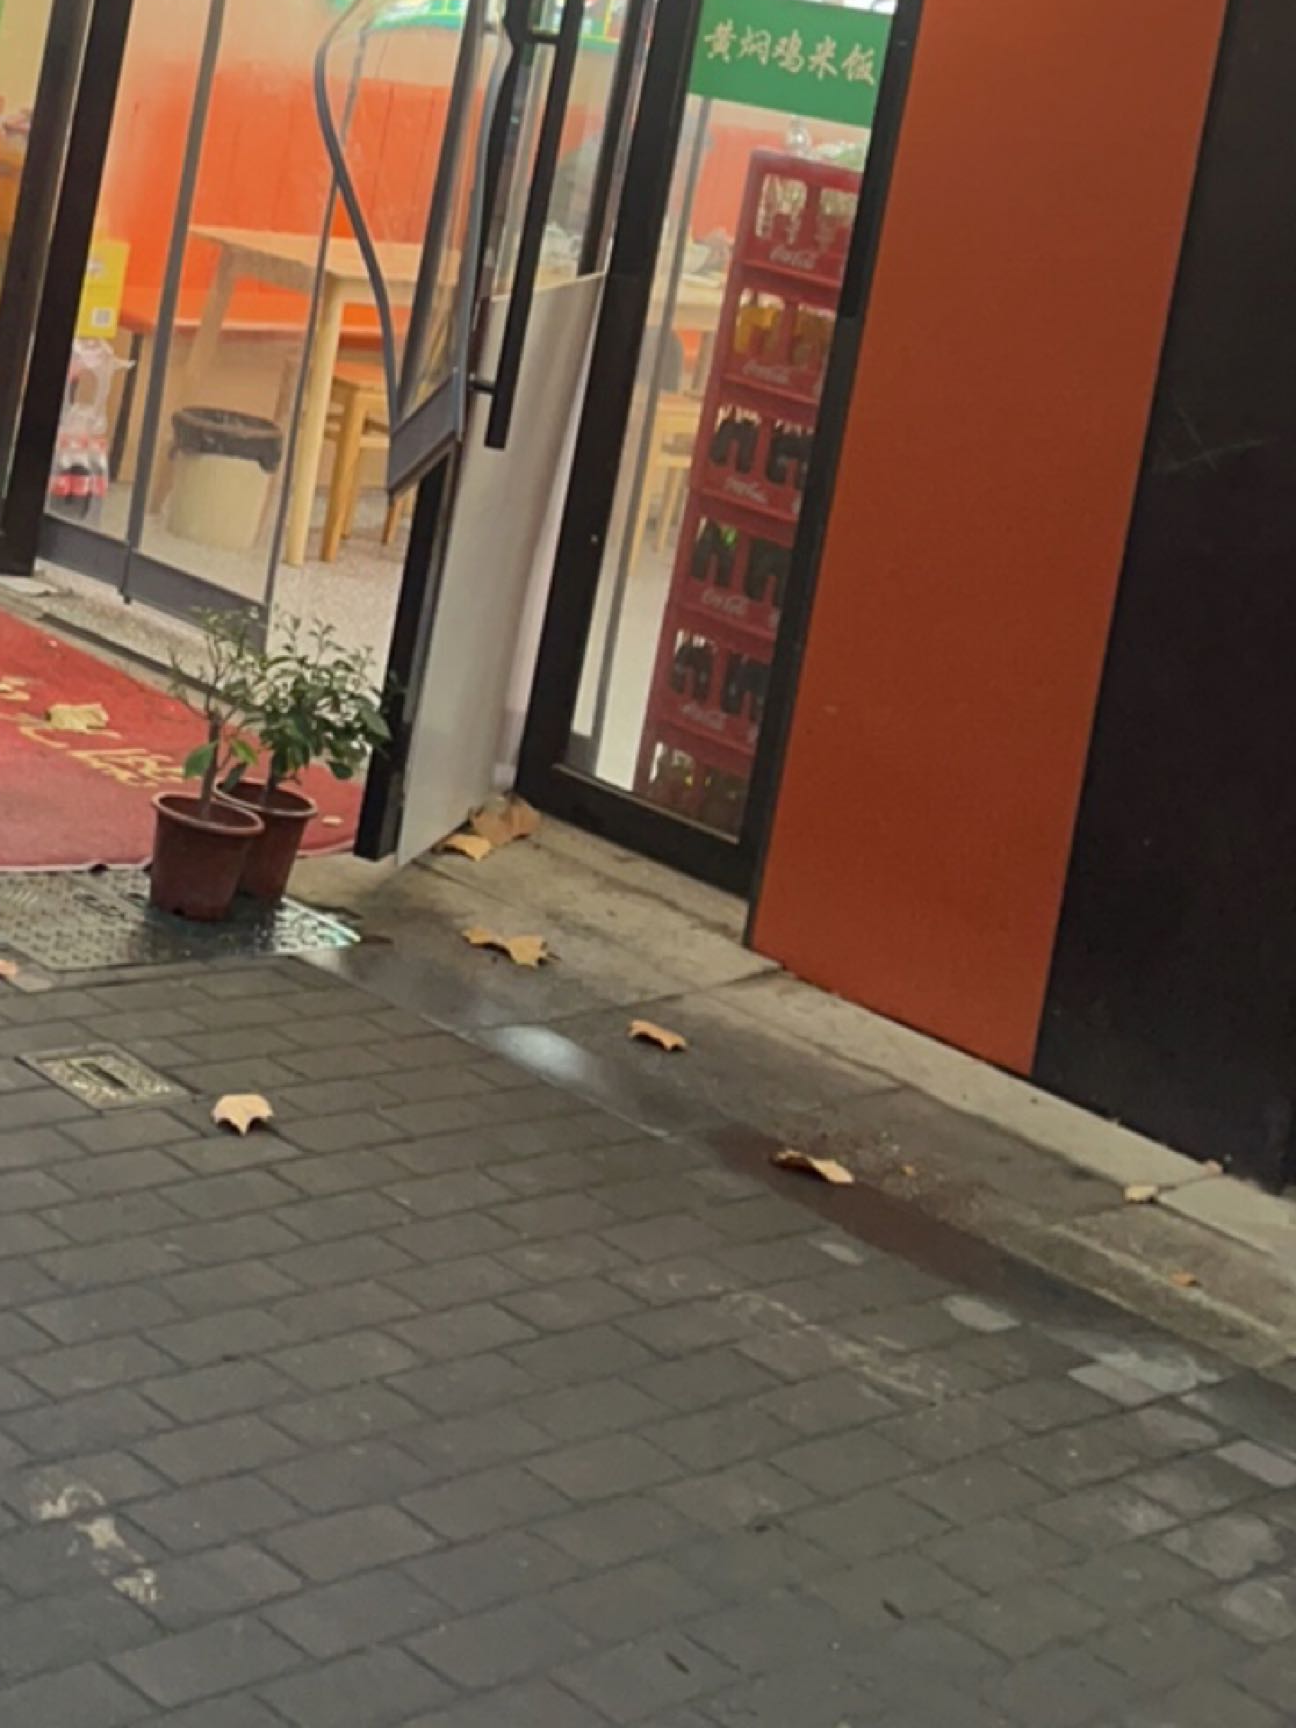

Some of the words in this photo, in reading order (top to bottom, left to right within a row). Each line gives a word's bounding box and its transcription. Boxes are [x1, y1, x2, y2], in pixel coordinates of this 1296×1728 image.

[705, 19, 875, 86] 黄焖鸡米饭
